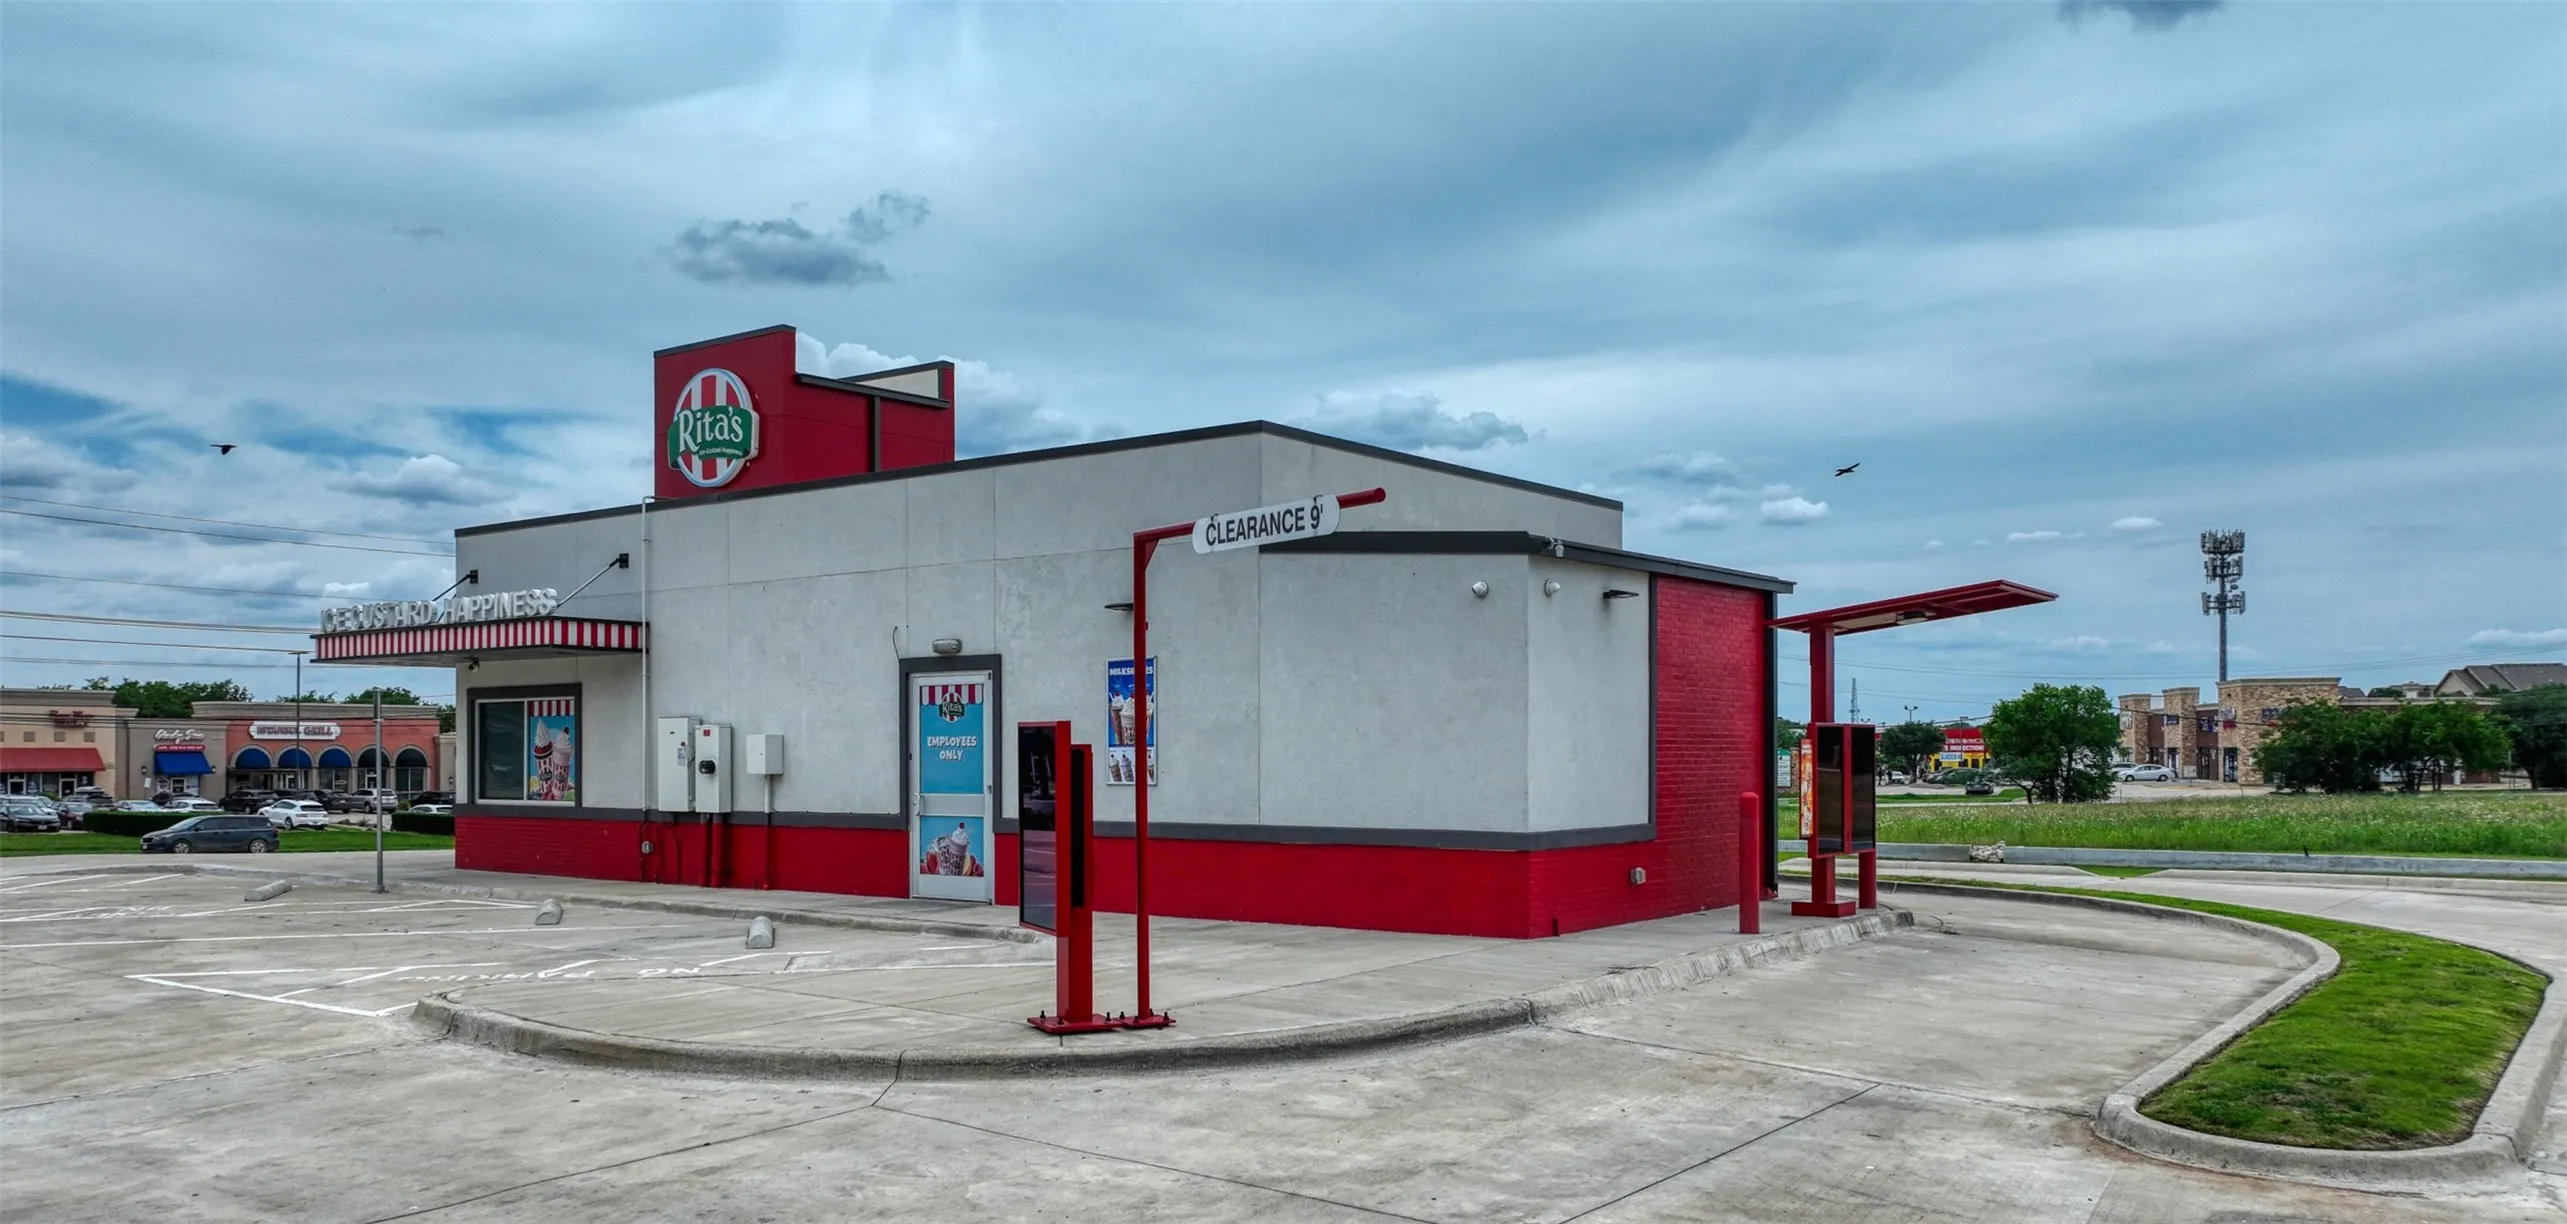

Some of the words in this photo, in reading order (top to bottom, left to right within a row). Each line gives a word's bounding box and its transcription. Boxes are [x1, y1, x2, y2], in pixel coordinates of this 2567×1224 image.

[677, 405, 744, 453] Rita's
[1206, 506, 1306, 546] CLEARANCE
[1310, 504, 1324, 530] 9'
[351, 600, 437, 630] CUSTARD
[443, 588, 557, 622] HAPPINESS
[1109, 666, 1153, 676] MILKSHES
[942, 702, 963, 714] Rita's
[927, 736, 977, 747] EMPLOYEES
[939, 749, 964, 760] ONLY
